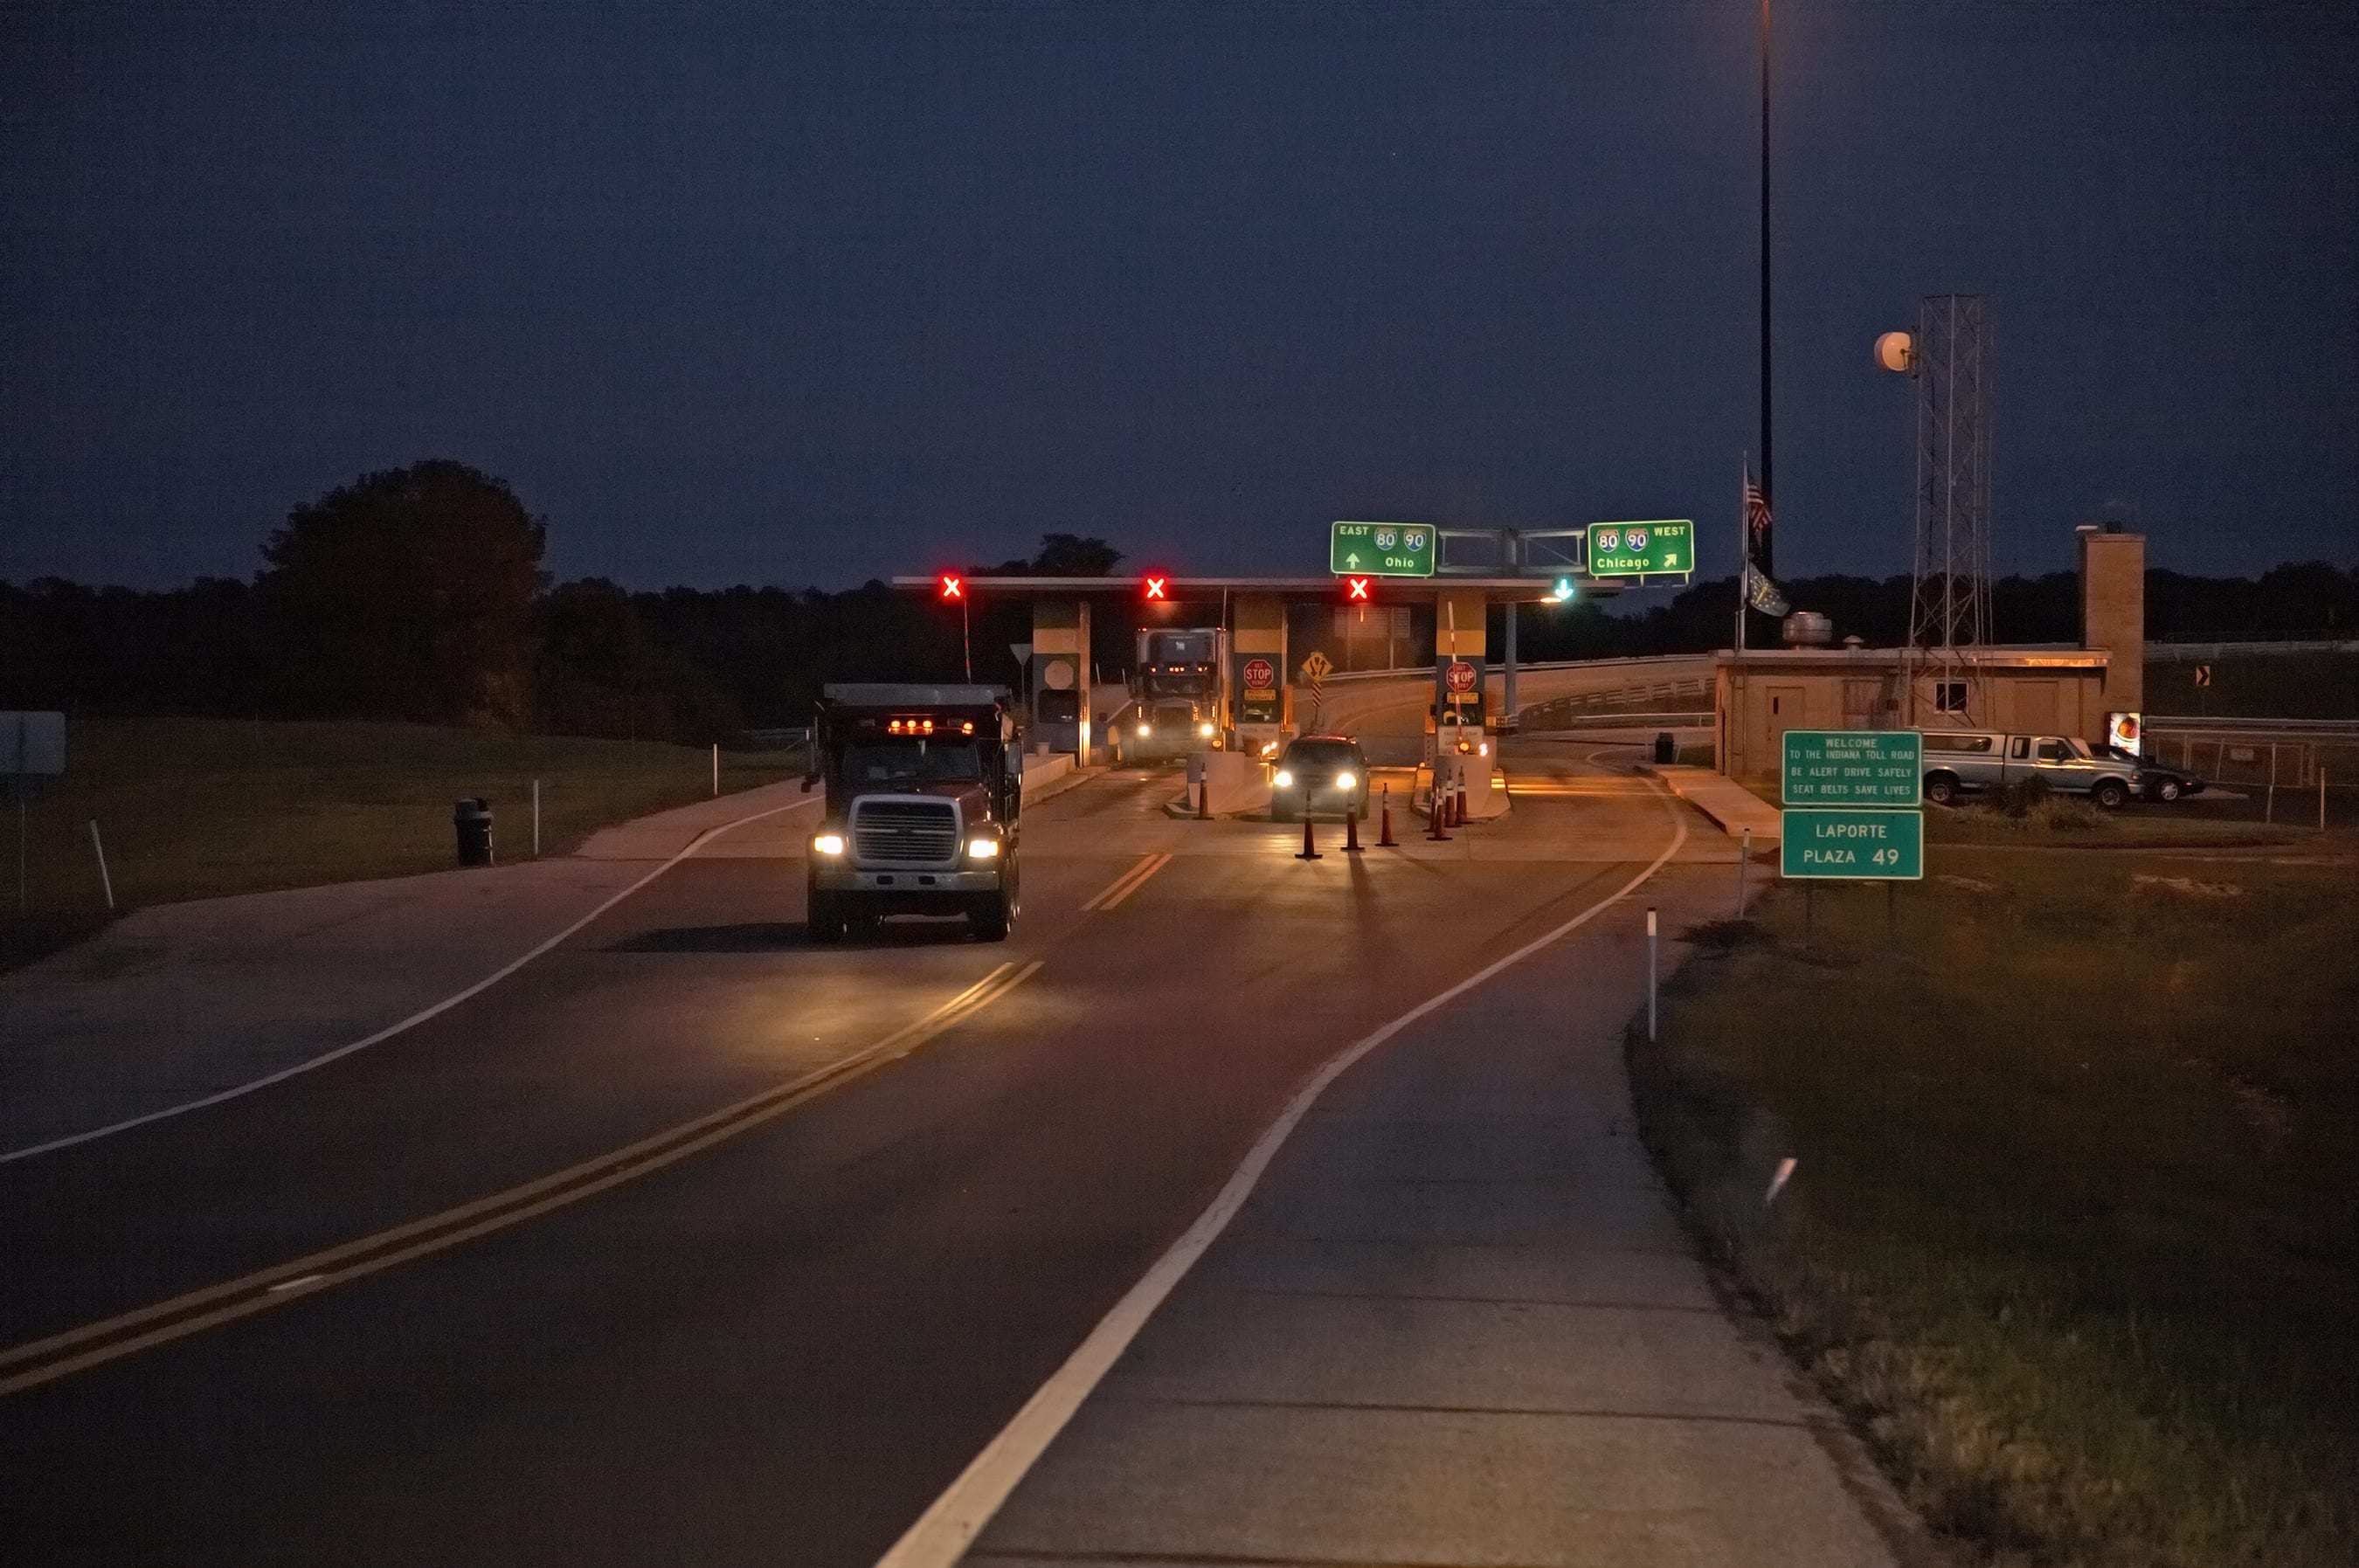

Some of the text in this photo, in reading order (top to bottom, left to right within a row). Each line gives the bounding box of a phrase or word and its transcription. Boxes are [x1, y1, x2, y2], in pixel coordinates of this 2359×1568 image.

[1339, 526, 1424, 547] EAST 80 90
[1599, 526, 1685, 548] 80 90 WEST
[1385, 556, 1414, 568] Ohio
[1596, 557, 1650, 570] Chicago
[1246, 669, 1271, 680] STOP
[1825, 738, 1877, 748] WELCOME
[1789, 749, 1914, 760] TO THE INDIANA TOLL ROAD
[1791, 767, 1912, 777] BE ALERT DRIVE SAFELY
[1793, 784, 1911, 795] SEAT BELTS SAVE LIVES
[1816, 825, 1887, 839] LAPORTE
[1803, 848, 1899, 865] PLAZA 49
